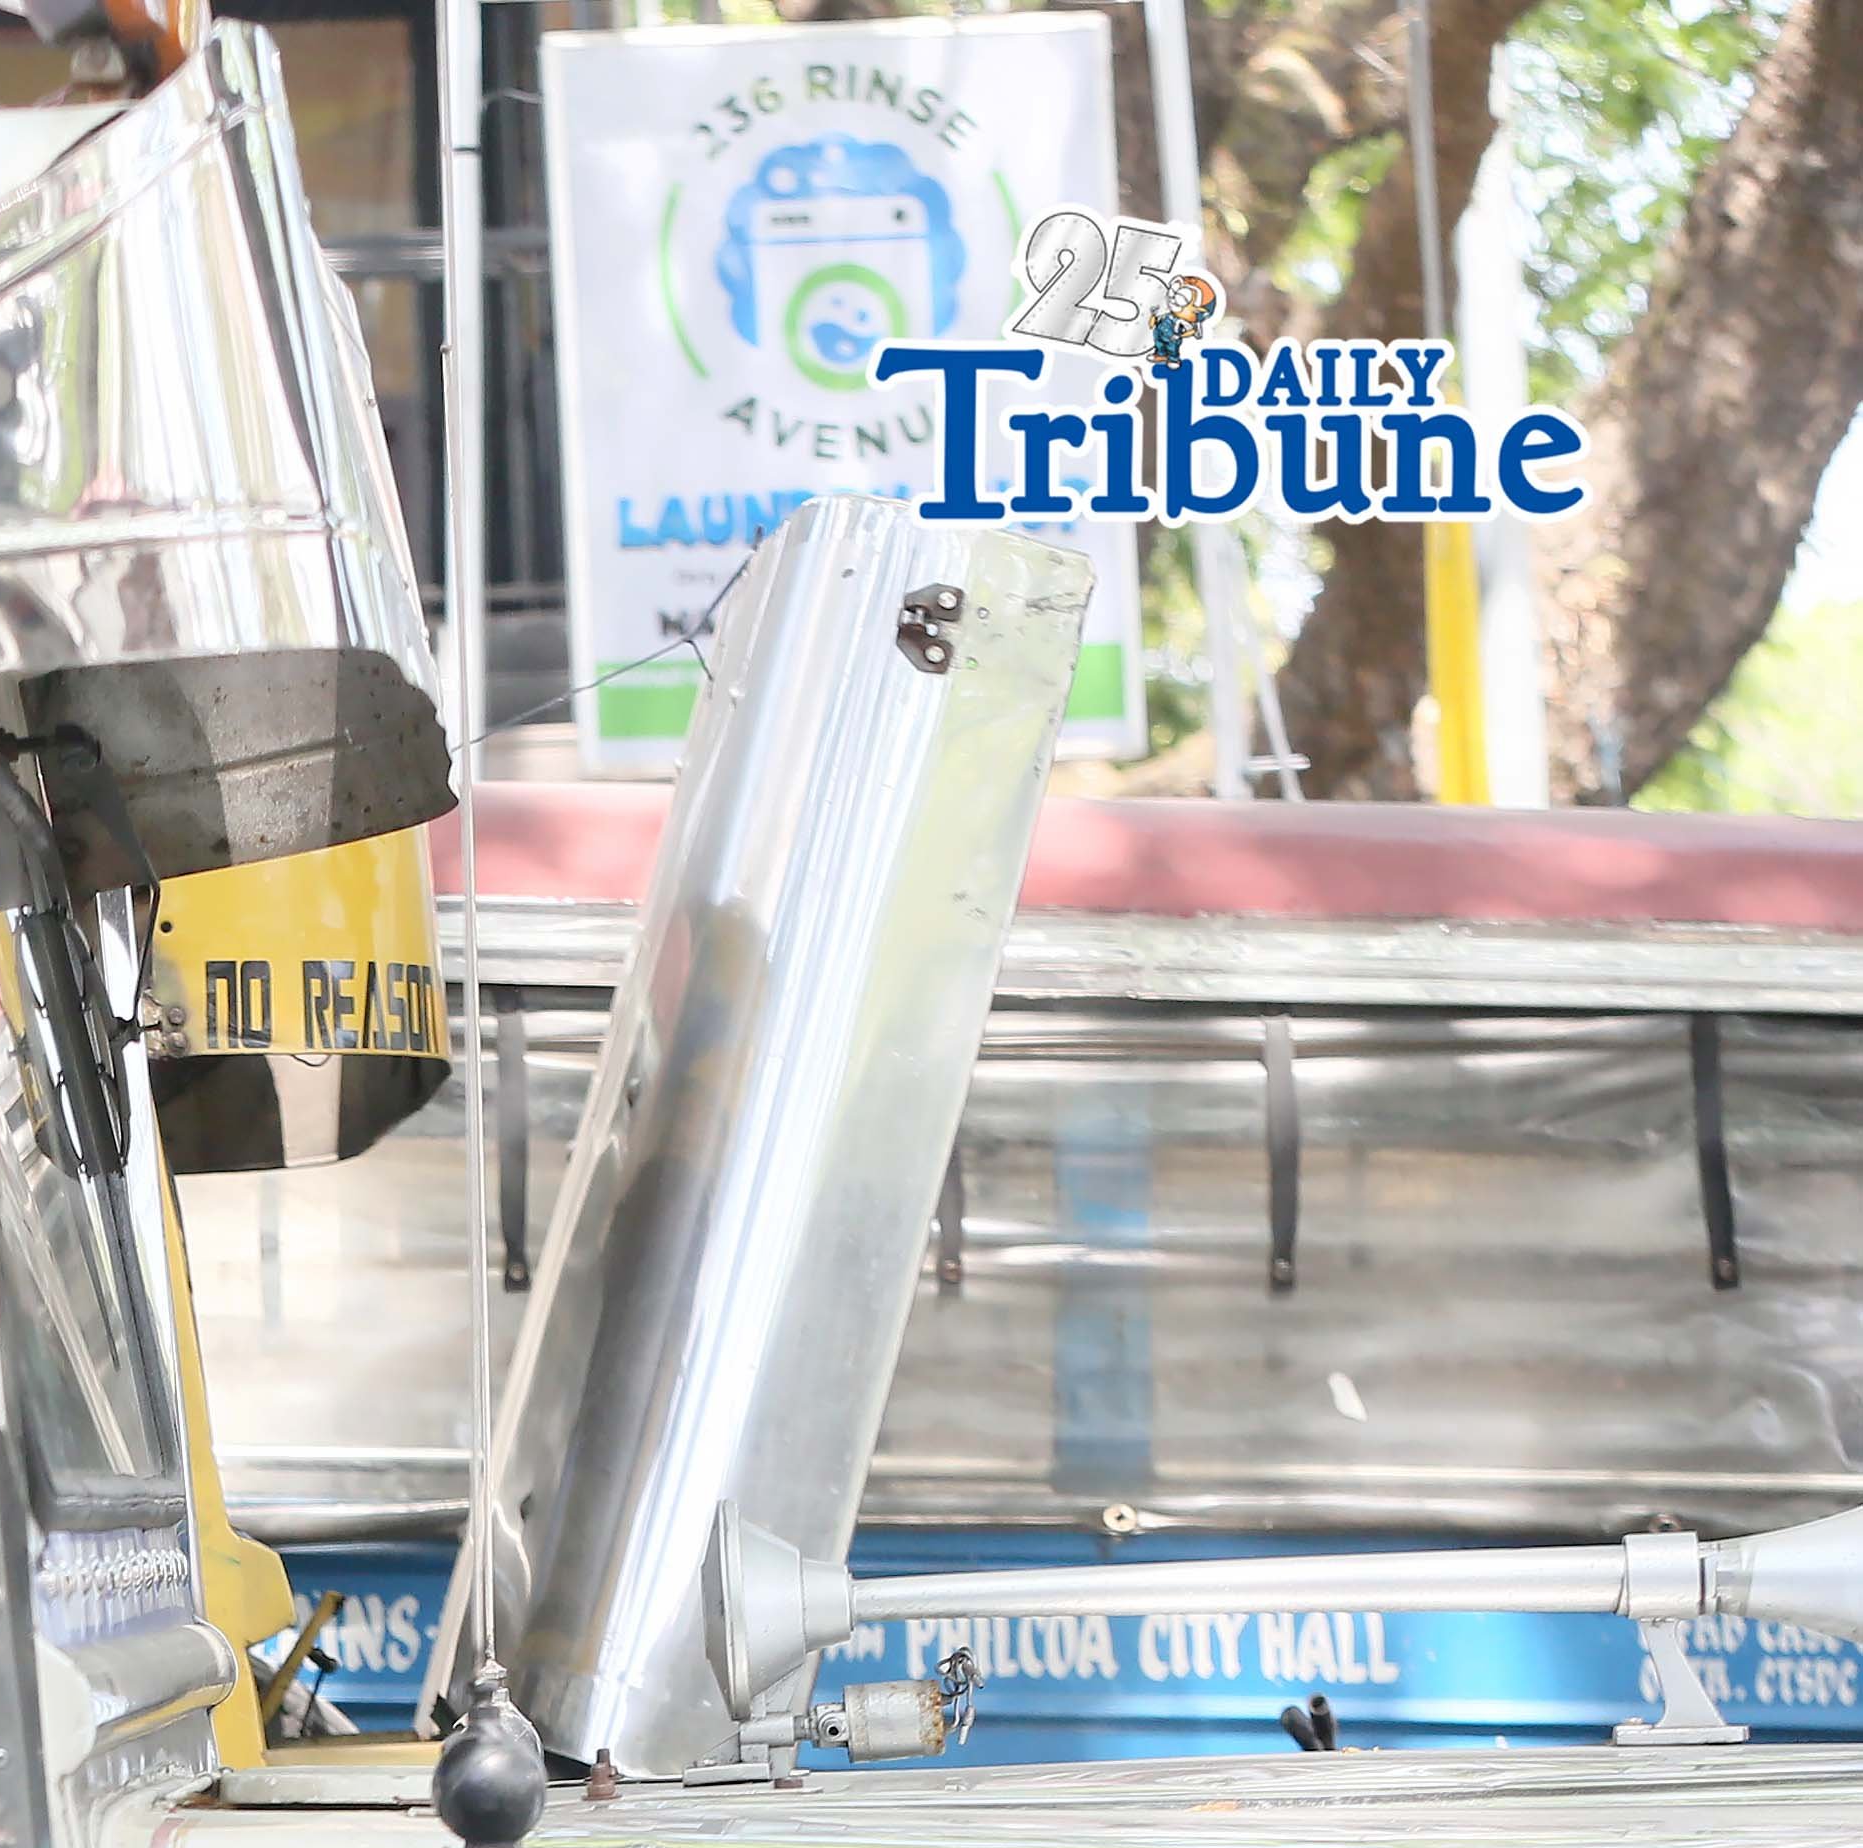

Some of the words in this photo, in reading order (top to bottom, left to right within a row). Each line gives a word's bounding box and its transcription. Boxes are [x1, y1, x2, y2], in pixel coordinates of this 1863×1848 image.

[805, 63, 980, 152] RINSE
[722, 396, 935, 460] AVENU
[204, 960, 272, 1049] NO
[301, 959, 440, 1053] REASON
[904, 1616, 1119, 1680] PHILCOA
[1138, 1613, 1248, 1682] CITY
[1258, 1612, 1400, 1684] HALL
